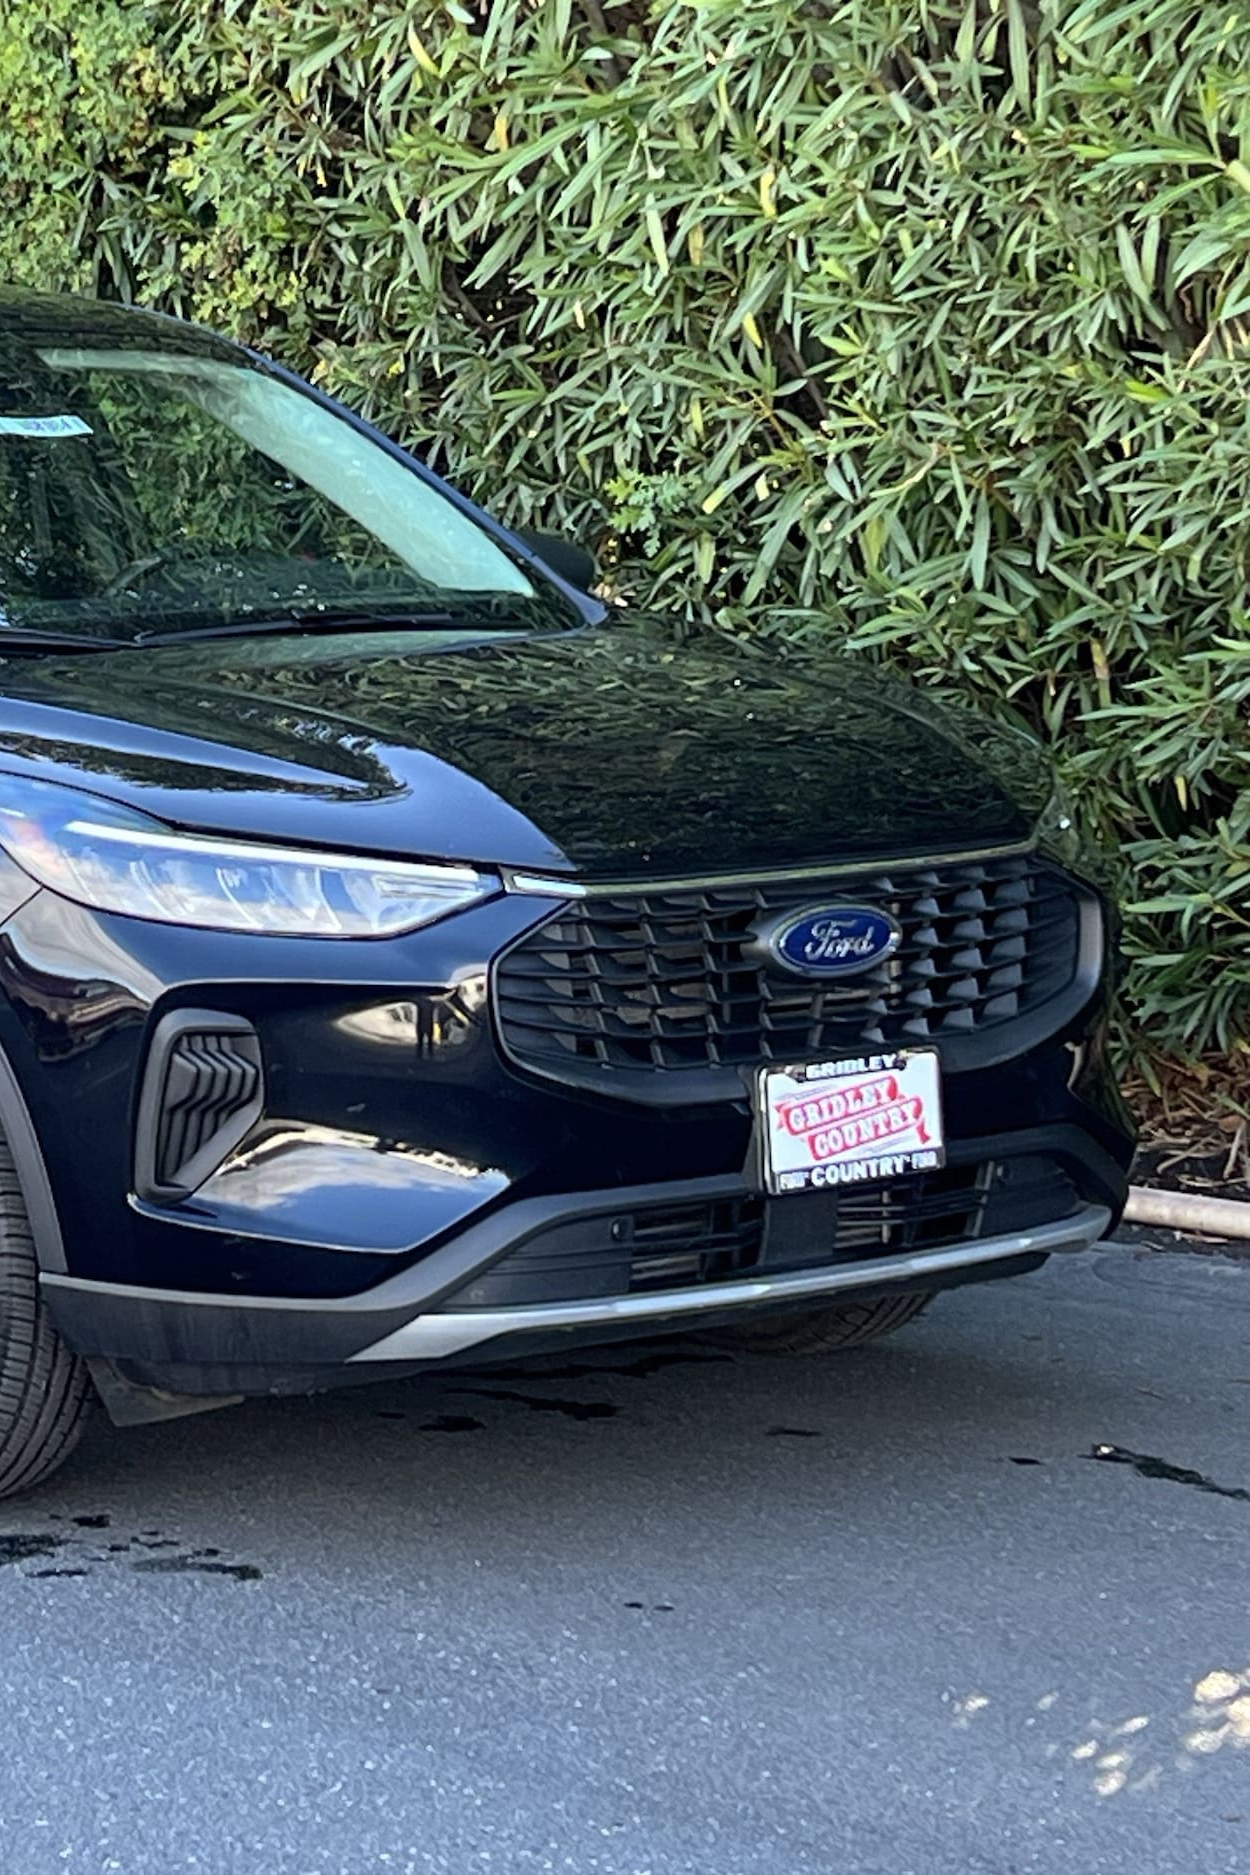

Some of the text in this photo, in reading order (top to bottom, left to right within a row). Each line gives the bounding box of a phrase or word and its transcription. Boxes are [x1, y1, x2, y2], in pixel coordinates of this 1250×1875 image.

[804, 919, 875, 961] Ford
[805, 1053, 898, 1080] GRIDLEY
[787, 1080, 894, 1130] GRIDLEY
[813, 1100, 918, 1153] COUNTRY
[810, 1156, 906, 1187] COUNTRY
